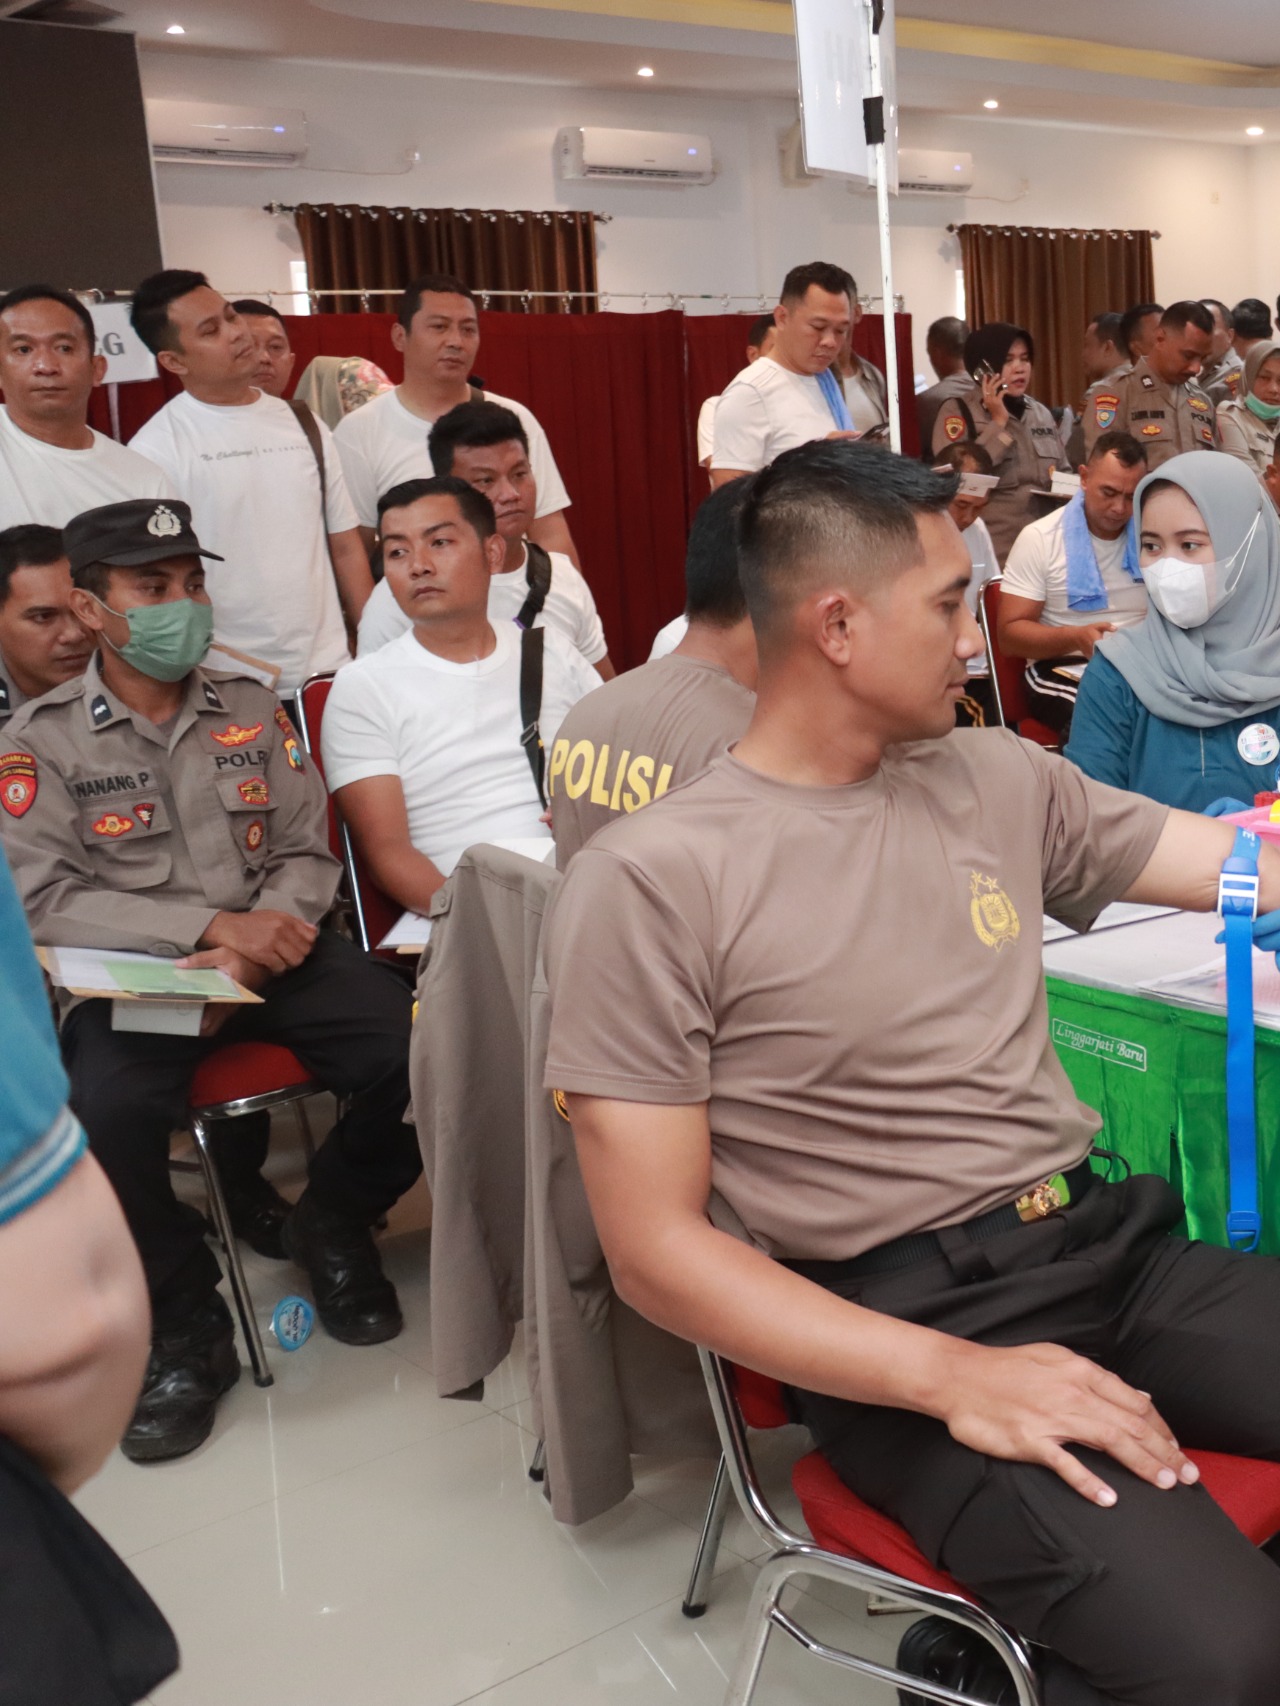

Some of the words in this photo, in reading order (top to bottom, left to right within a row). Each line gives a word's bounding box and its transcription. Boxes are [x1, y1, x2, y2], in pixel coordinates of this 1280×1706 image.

[74, 775, 137, 798] NANANG
[138, 772, 149, 787] P
[549, 738, 674, 815] POLISI
[1056, 1023, 1114, 1053] Linggarjati
[1116, 1042, 1144, 1063] Baru
